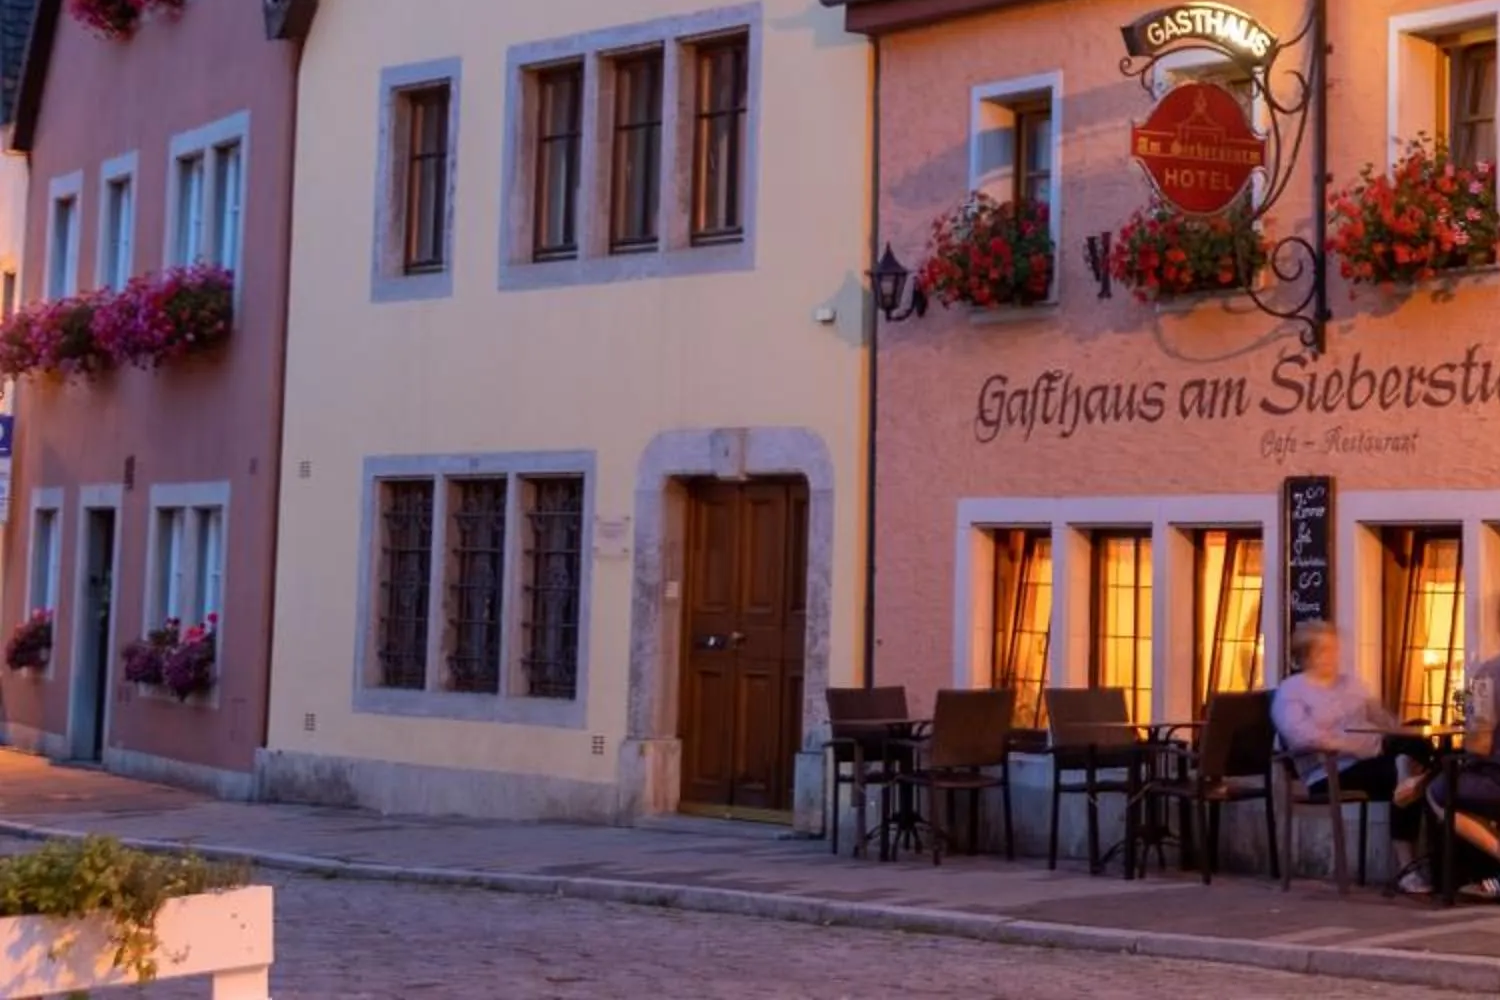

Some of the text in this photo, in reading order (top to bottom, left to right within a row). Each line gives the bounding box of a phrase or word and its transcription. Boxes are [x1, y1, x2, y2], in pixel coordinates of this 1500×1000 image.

[1147, 8, 1271, 57] GASTHAUS
[1164, 168, 1234, 191] HOTEL
[1179, 376, 1252, 420] am
[1324, 425, 1420, 456] Restaurant
